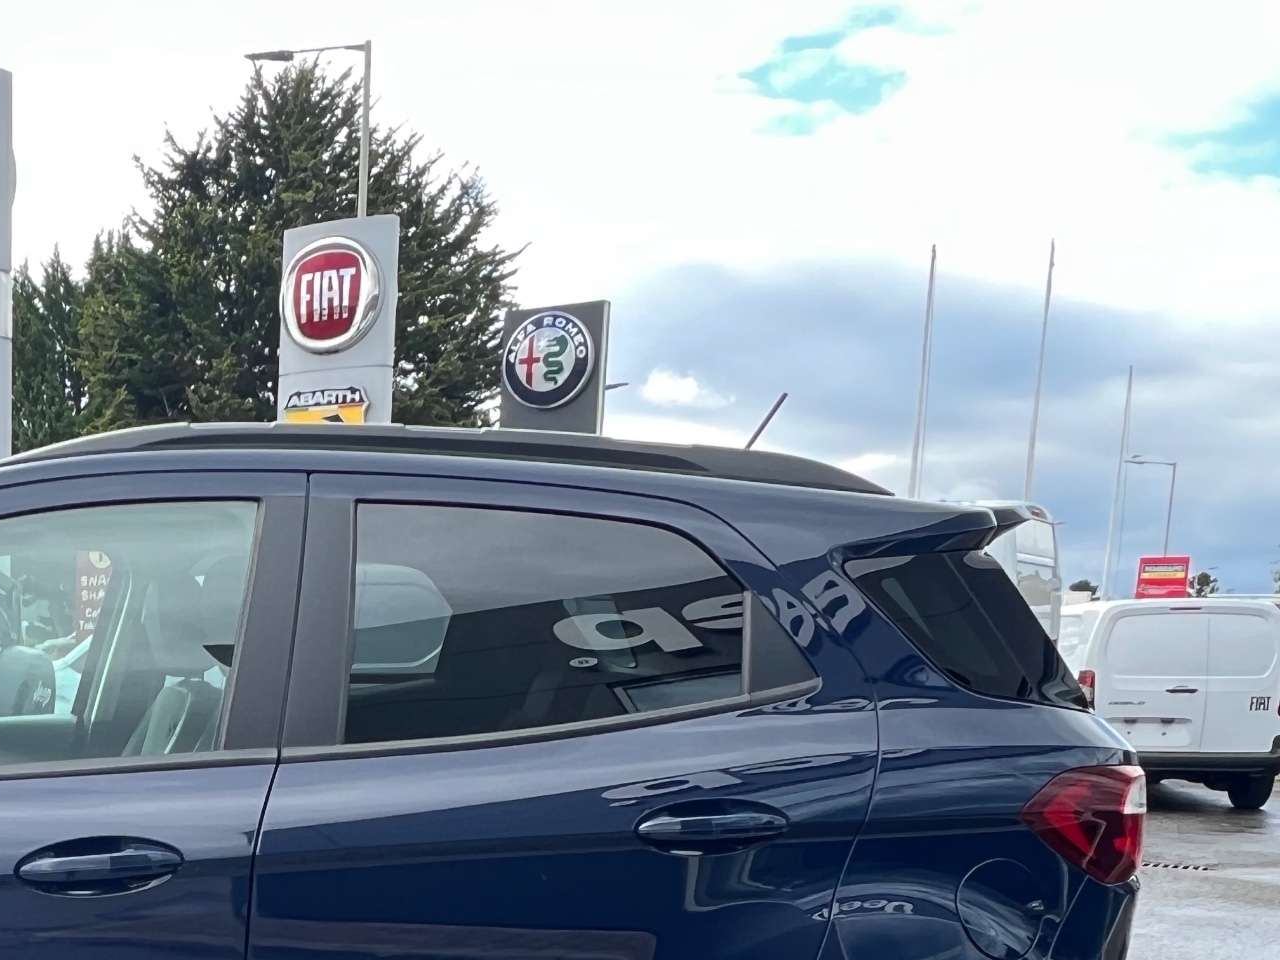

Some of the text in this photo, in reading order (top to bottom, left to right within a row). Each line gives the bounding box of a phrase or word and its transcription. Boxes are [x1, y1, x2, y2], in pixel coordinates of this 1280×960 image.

[300, 266, 357, 324] FIAT
[508, 316, 587, 363] ALFA ROMEO
[287, 390, 361, 408] ABARTH
[1249, 696, 1271, 711] FIAT
